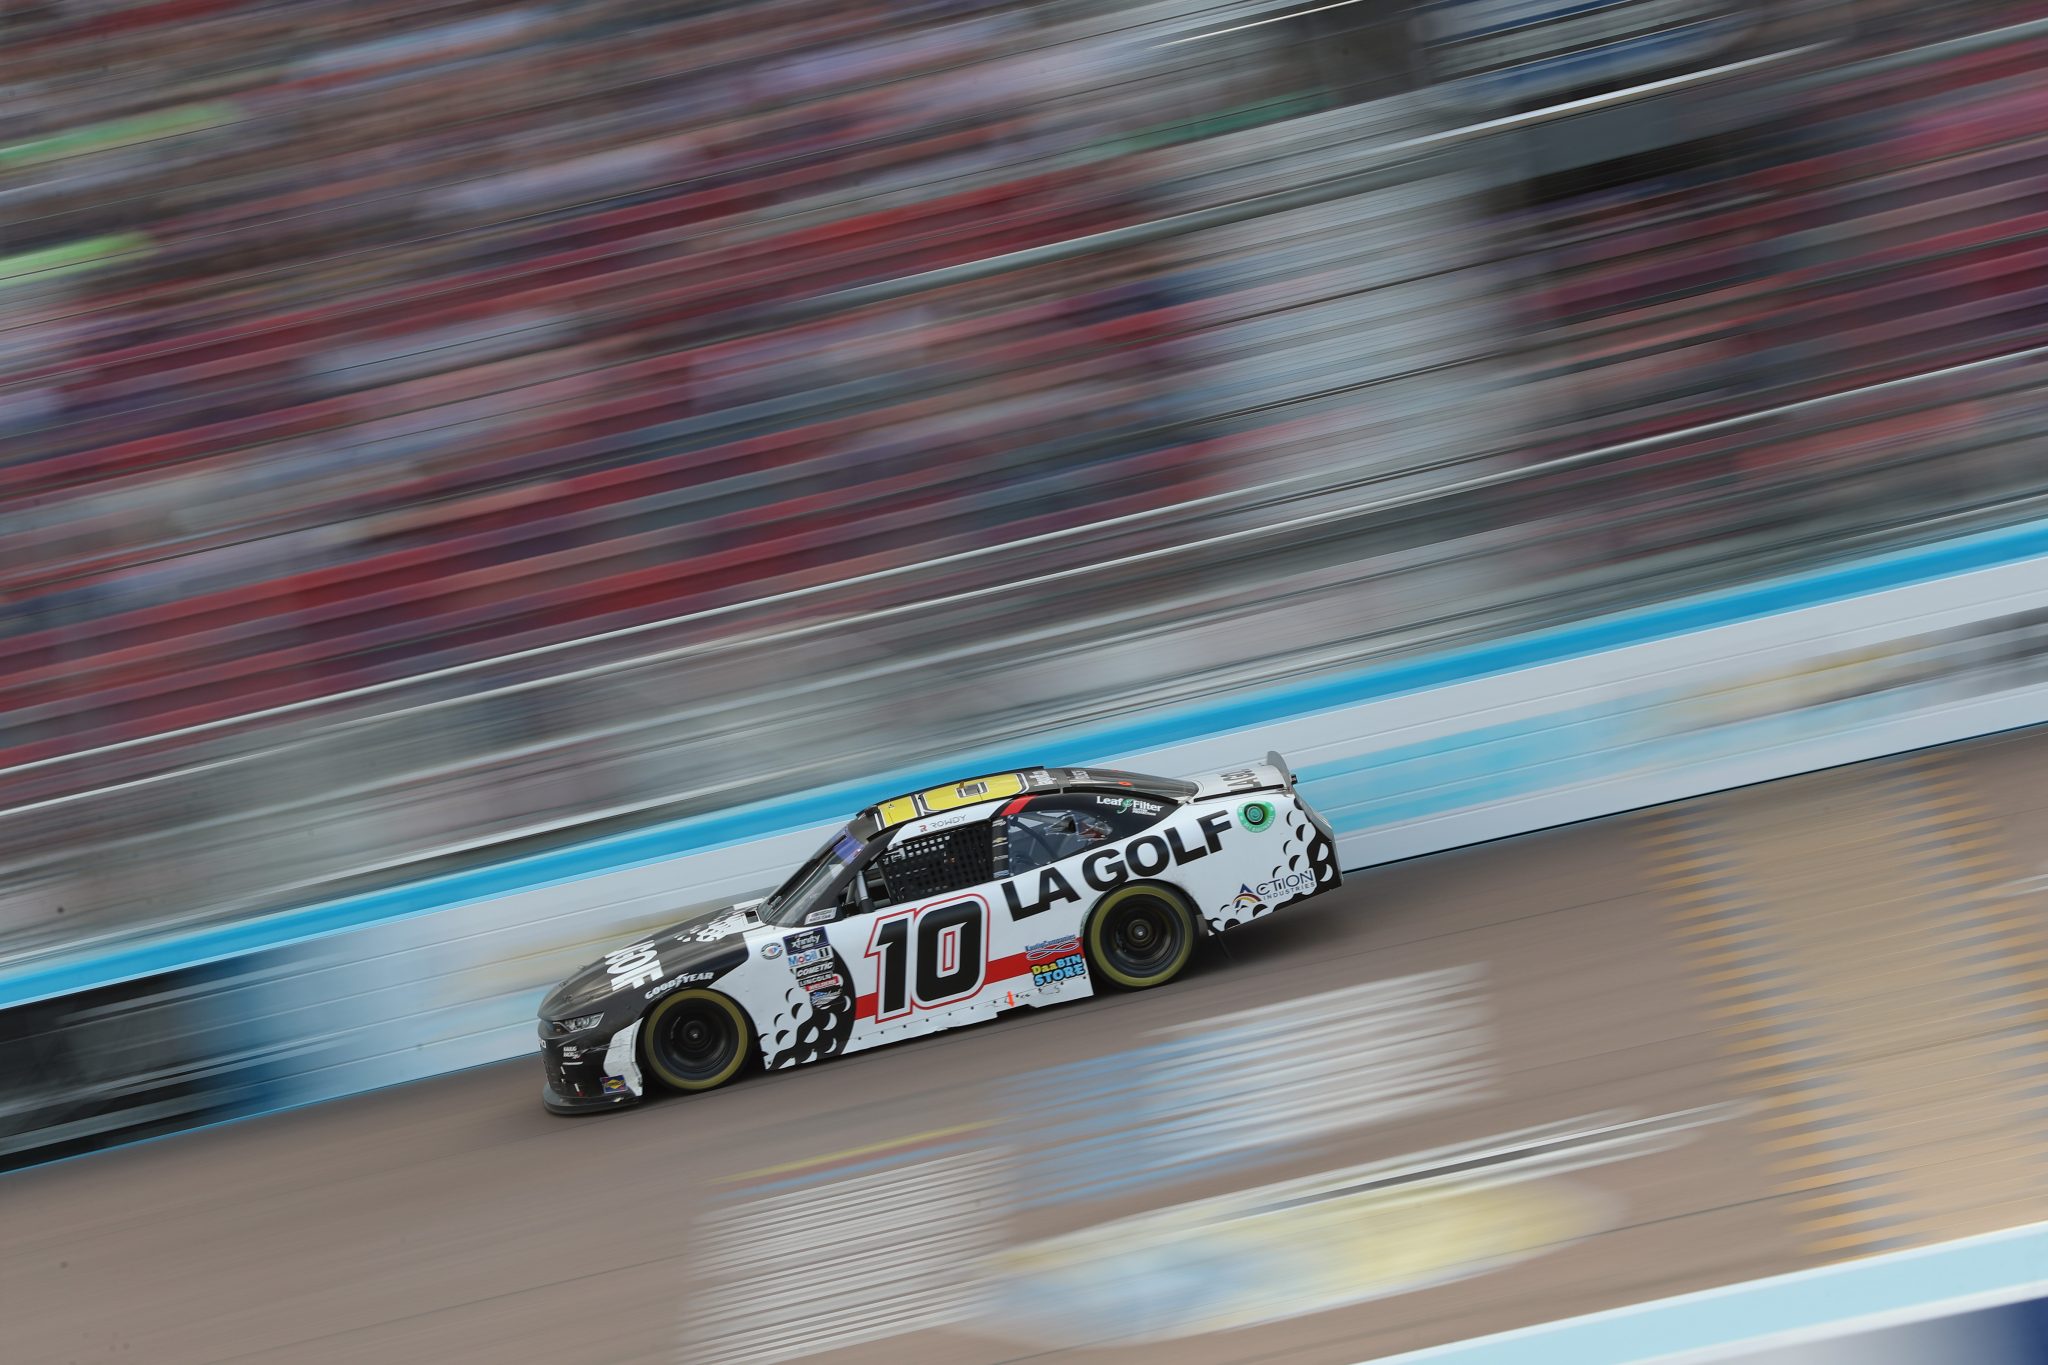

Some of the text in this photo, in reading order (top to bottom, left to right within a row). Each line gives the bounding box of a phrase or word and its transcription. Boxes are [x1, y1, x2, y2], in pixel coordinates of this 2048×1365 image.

[930, 815, 967, 829] ROWDY
[1001, 867, 1081, 921] LA
[1082, 810, 1232, 892] GOLF
[1263, 882, 1315, 901] INDUSTRIES
[787, 951, 817, 966] Mobil
[796, 961, 834, 977] COMETIC
[868, 896, 985, 1020] 10
[1034, 962, 1085, 987] STORE
[644, 973, 714, 1000] GOODYEAR
